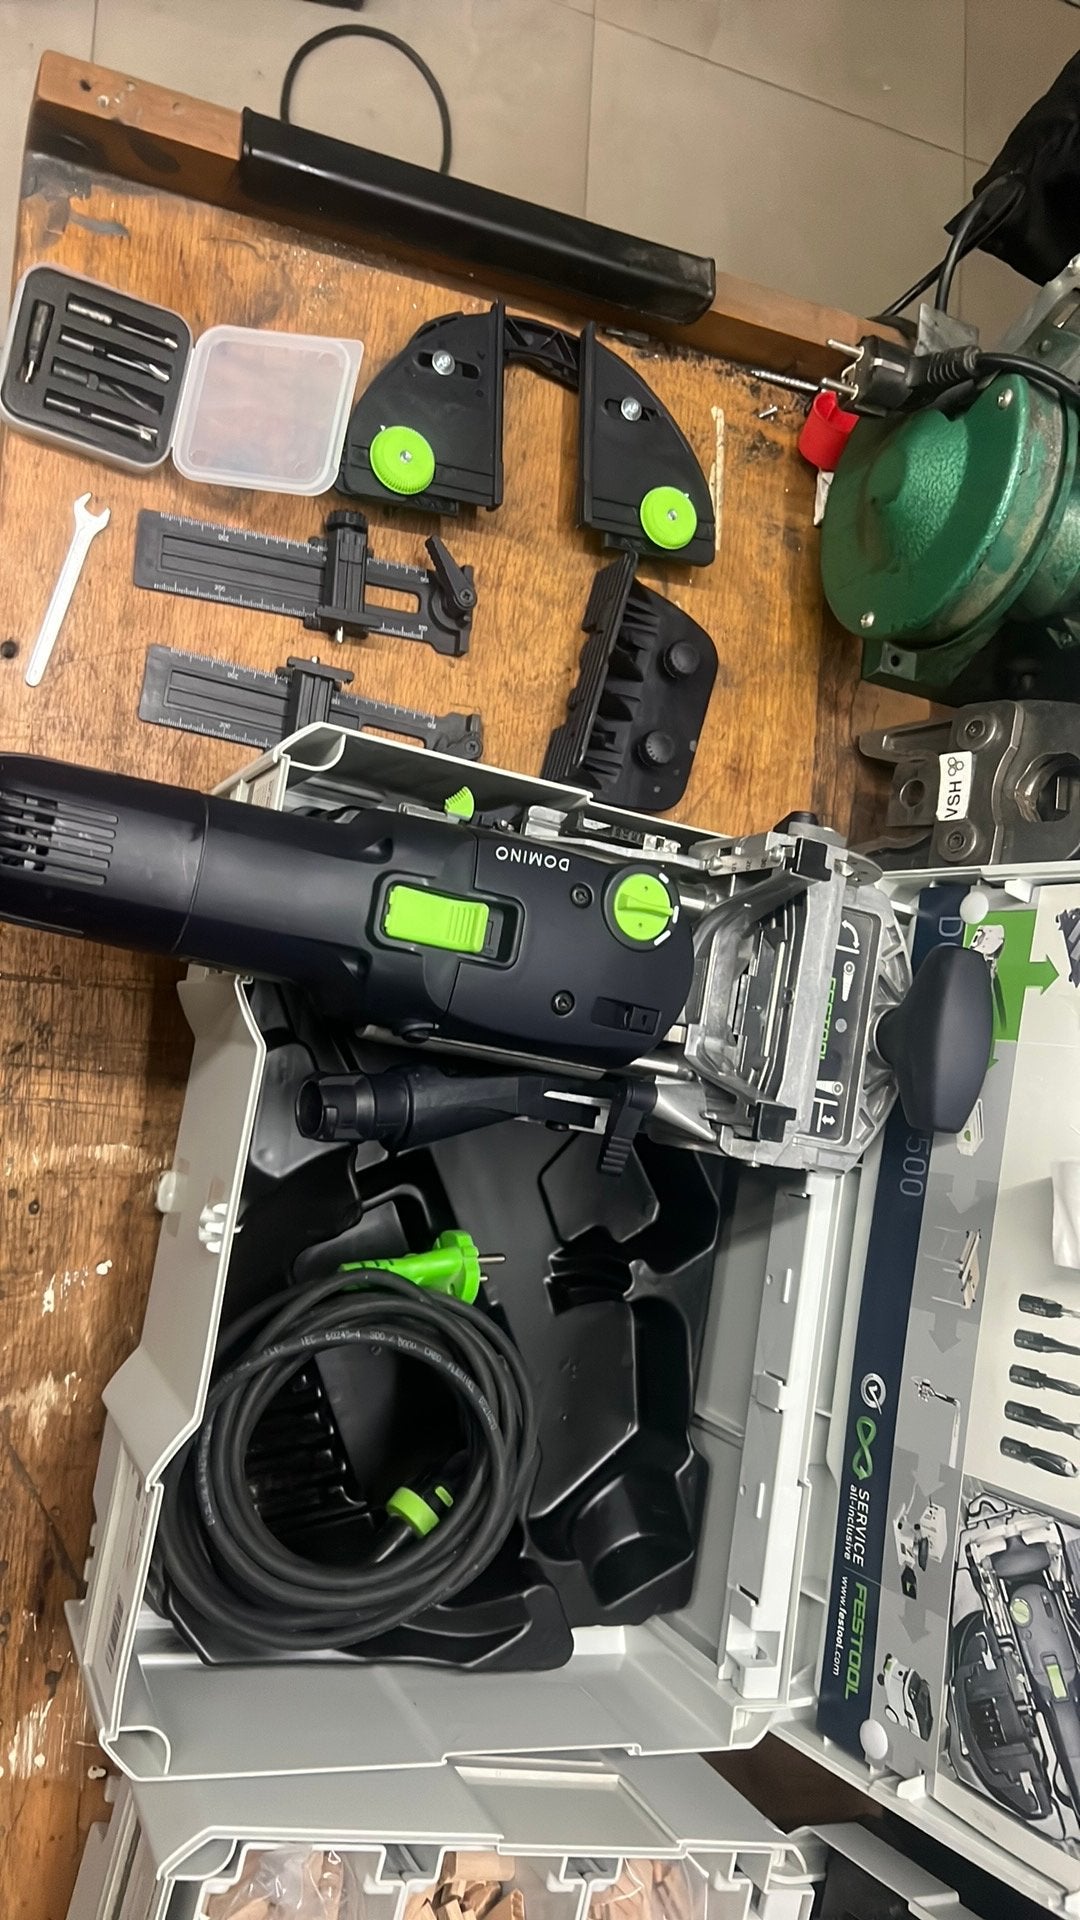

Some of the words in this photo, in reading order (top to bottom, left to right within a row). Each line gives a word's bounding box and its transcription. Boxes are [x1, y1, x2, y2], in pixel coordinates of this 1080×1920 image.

[944, 780, 962, 819] VSH
[495, 846, 570, 872] DOMINO
[900, 1135, 930, 1197] 500
[843, 1484, 856, 1561] all-inclusive
[852, 1488, 870, 1568] SERVICE
[832, 1576, 849, 1677] www.festool.com
[844, 1582, 868, 1700] FESTOOL
